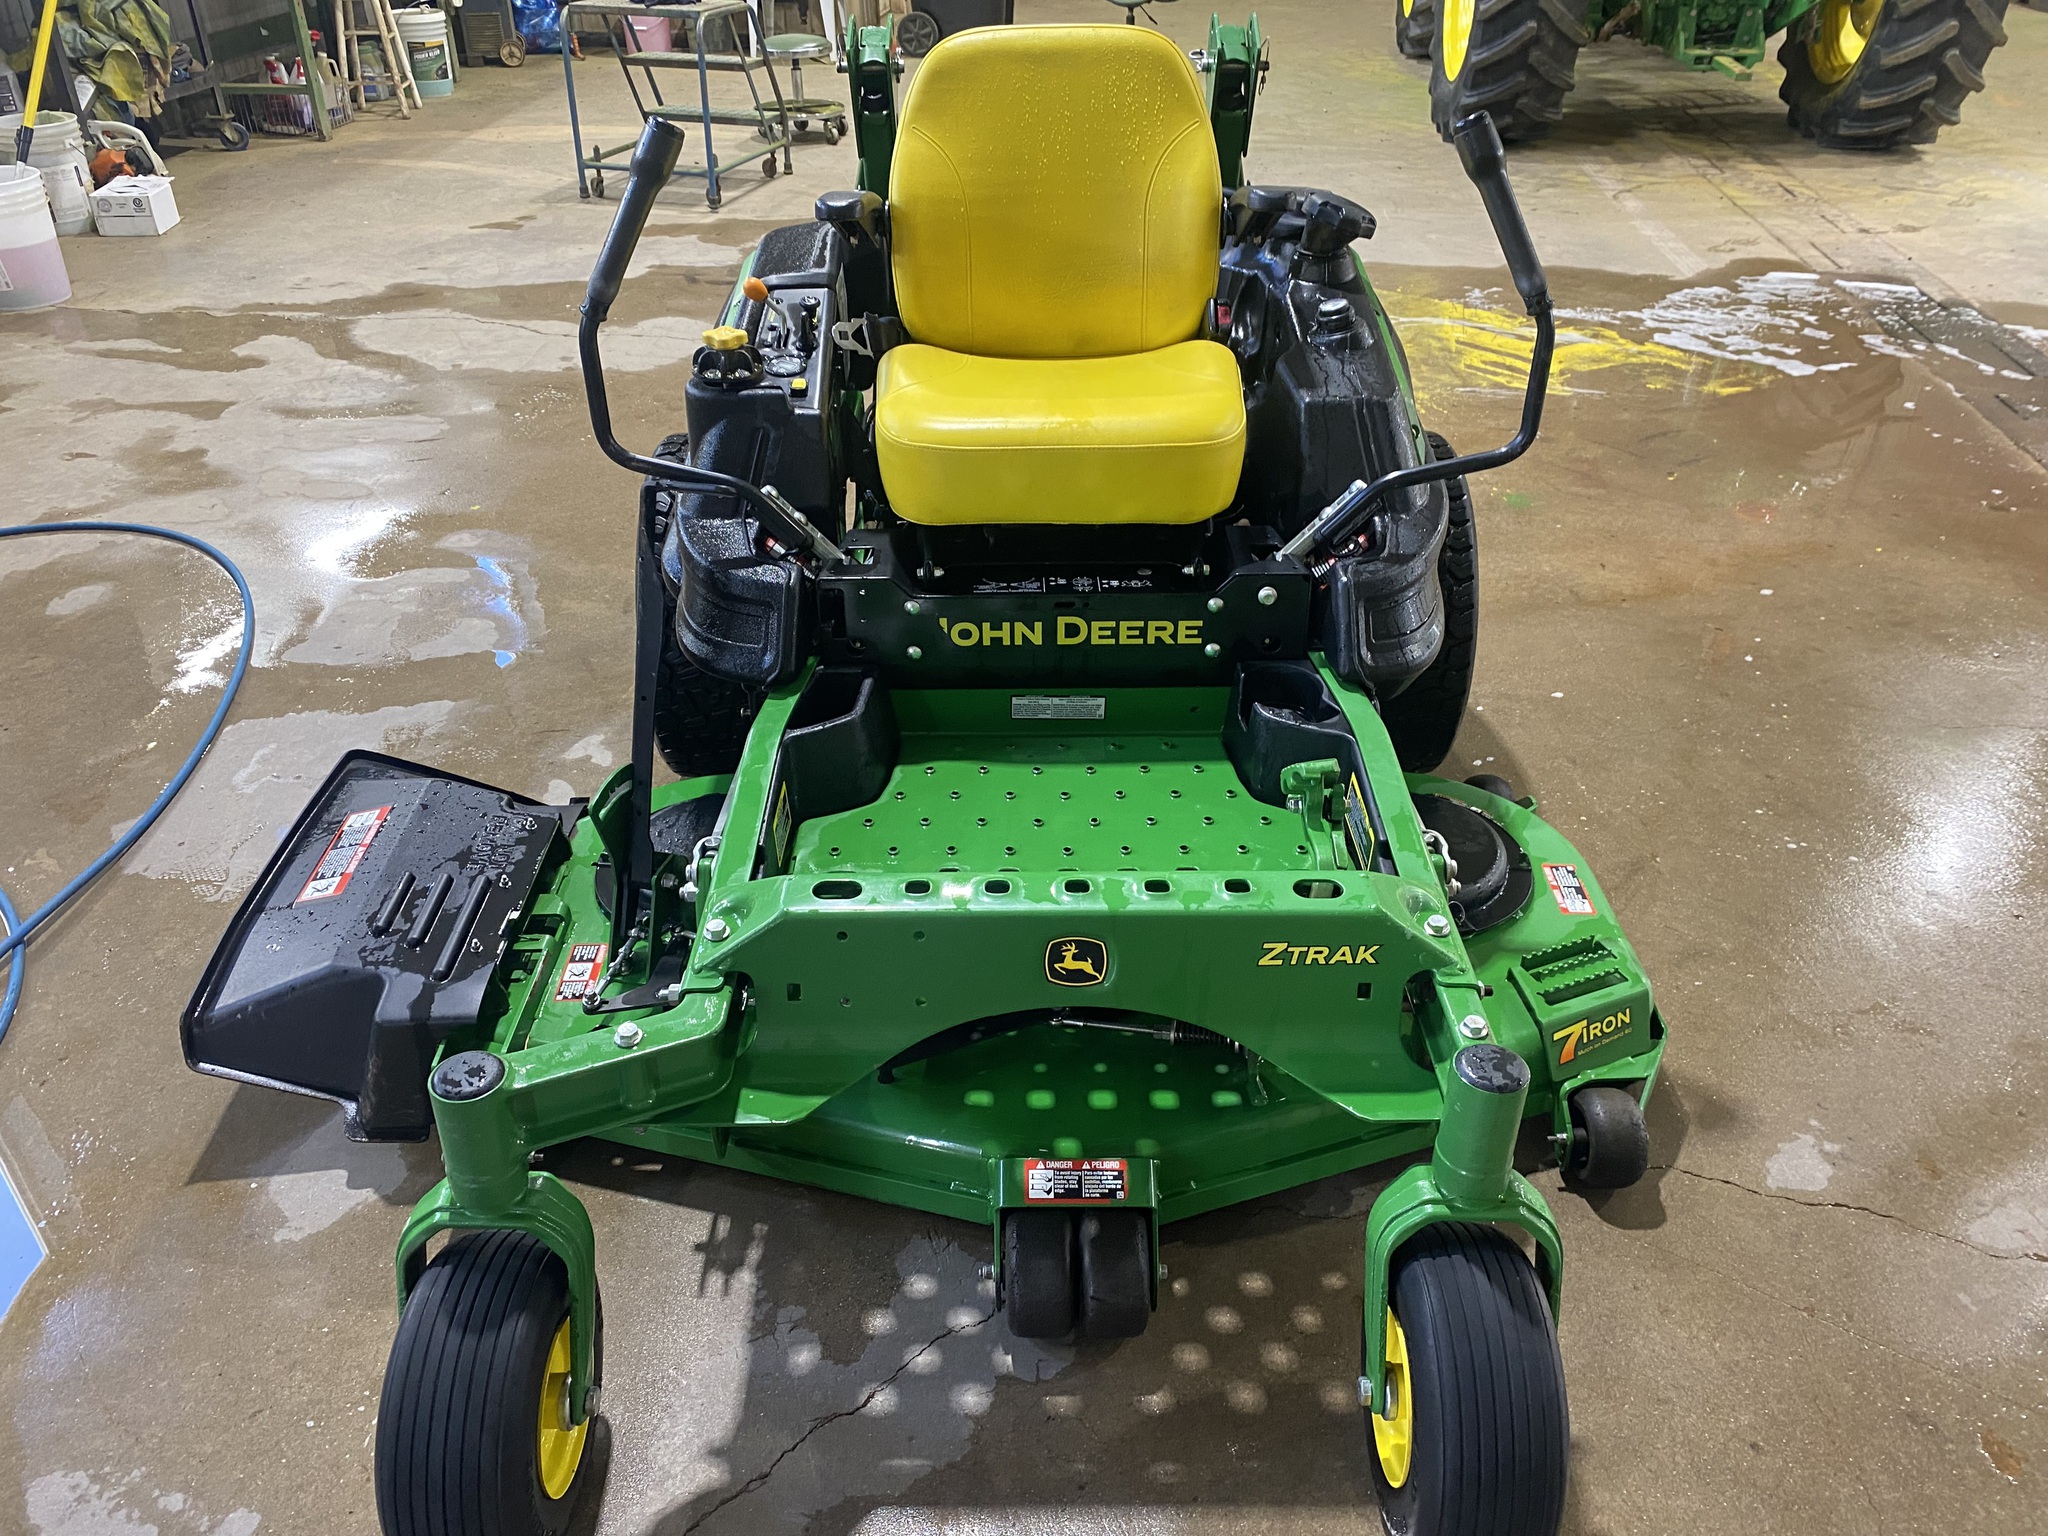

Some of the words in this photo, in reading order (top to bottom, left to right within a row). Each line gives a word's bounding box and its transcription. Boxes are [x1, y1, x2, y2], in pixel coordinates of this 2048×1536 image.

[1056, 615, 1204, 645] DEERE
[1257, 941, 1382, 967] ZTRAK
[1046, 1160, 1073, 1169] DANGER
[1091, 1160, 1120, 1169] PELIGRO
